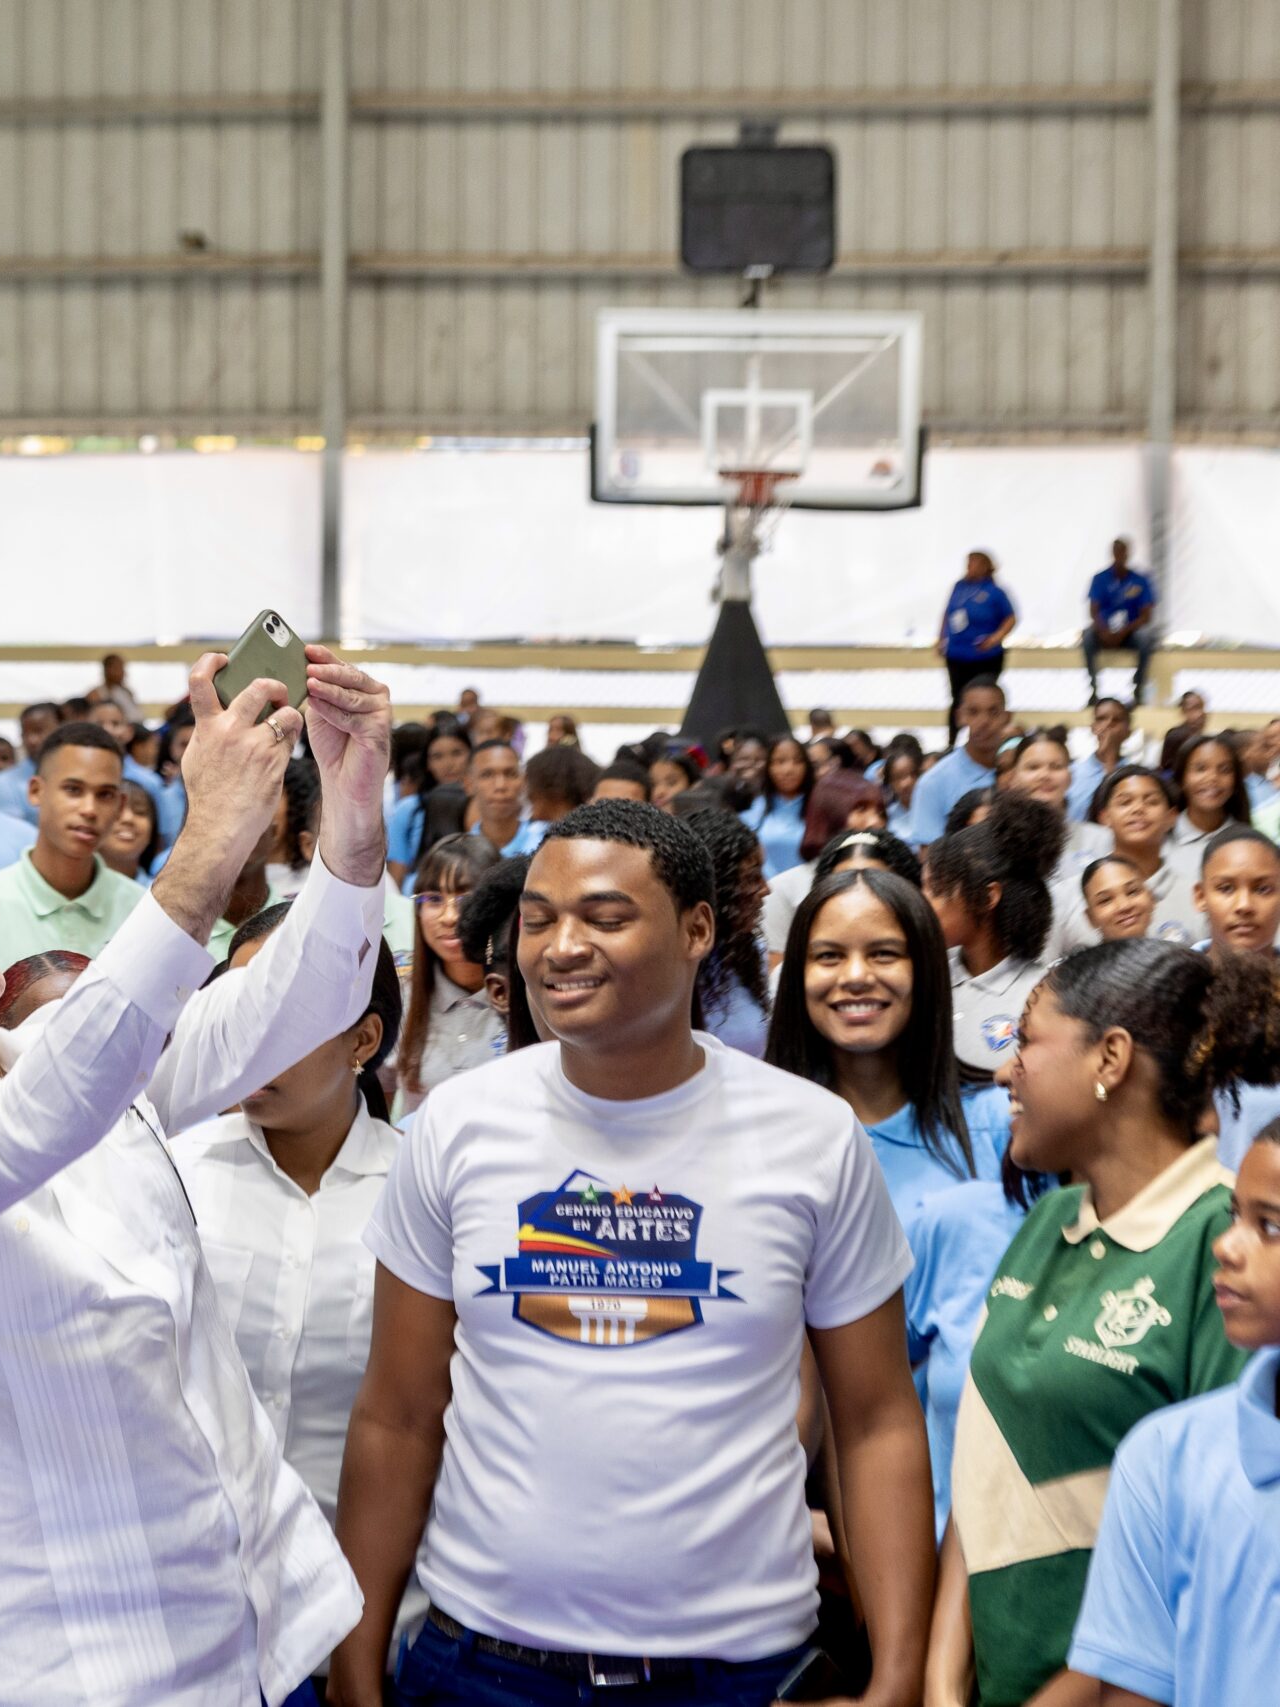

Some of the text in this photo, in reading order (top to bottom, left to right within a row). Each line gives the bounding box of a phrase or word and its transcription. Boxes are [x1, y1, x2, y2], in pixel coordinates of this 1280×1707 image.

[555, 1203, 694, 1220] CENTRO EDUCATIVO
[572, 1218, 691, 1241] EN ARTES
[531, 1259, 681, 1276] MANUEL ANTONIO
[550, 1273, 662, 1288] PATIN MACEO
